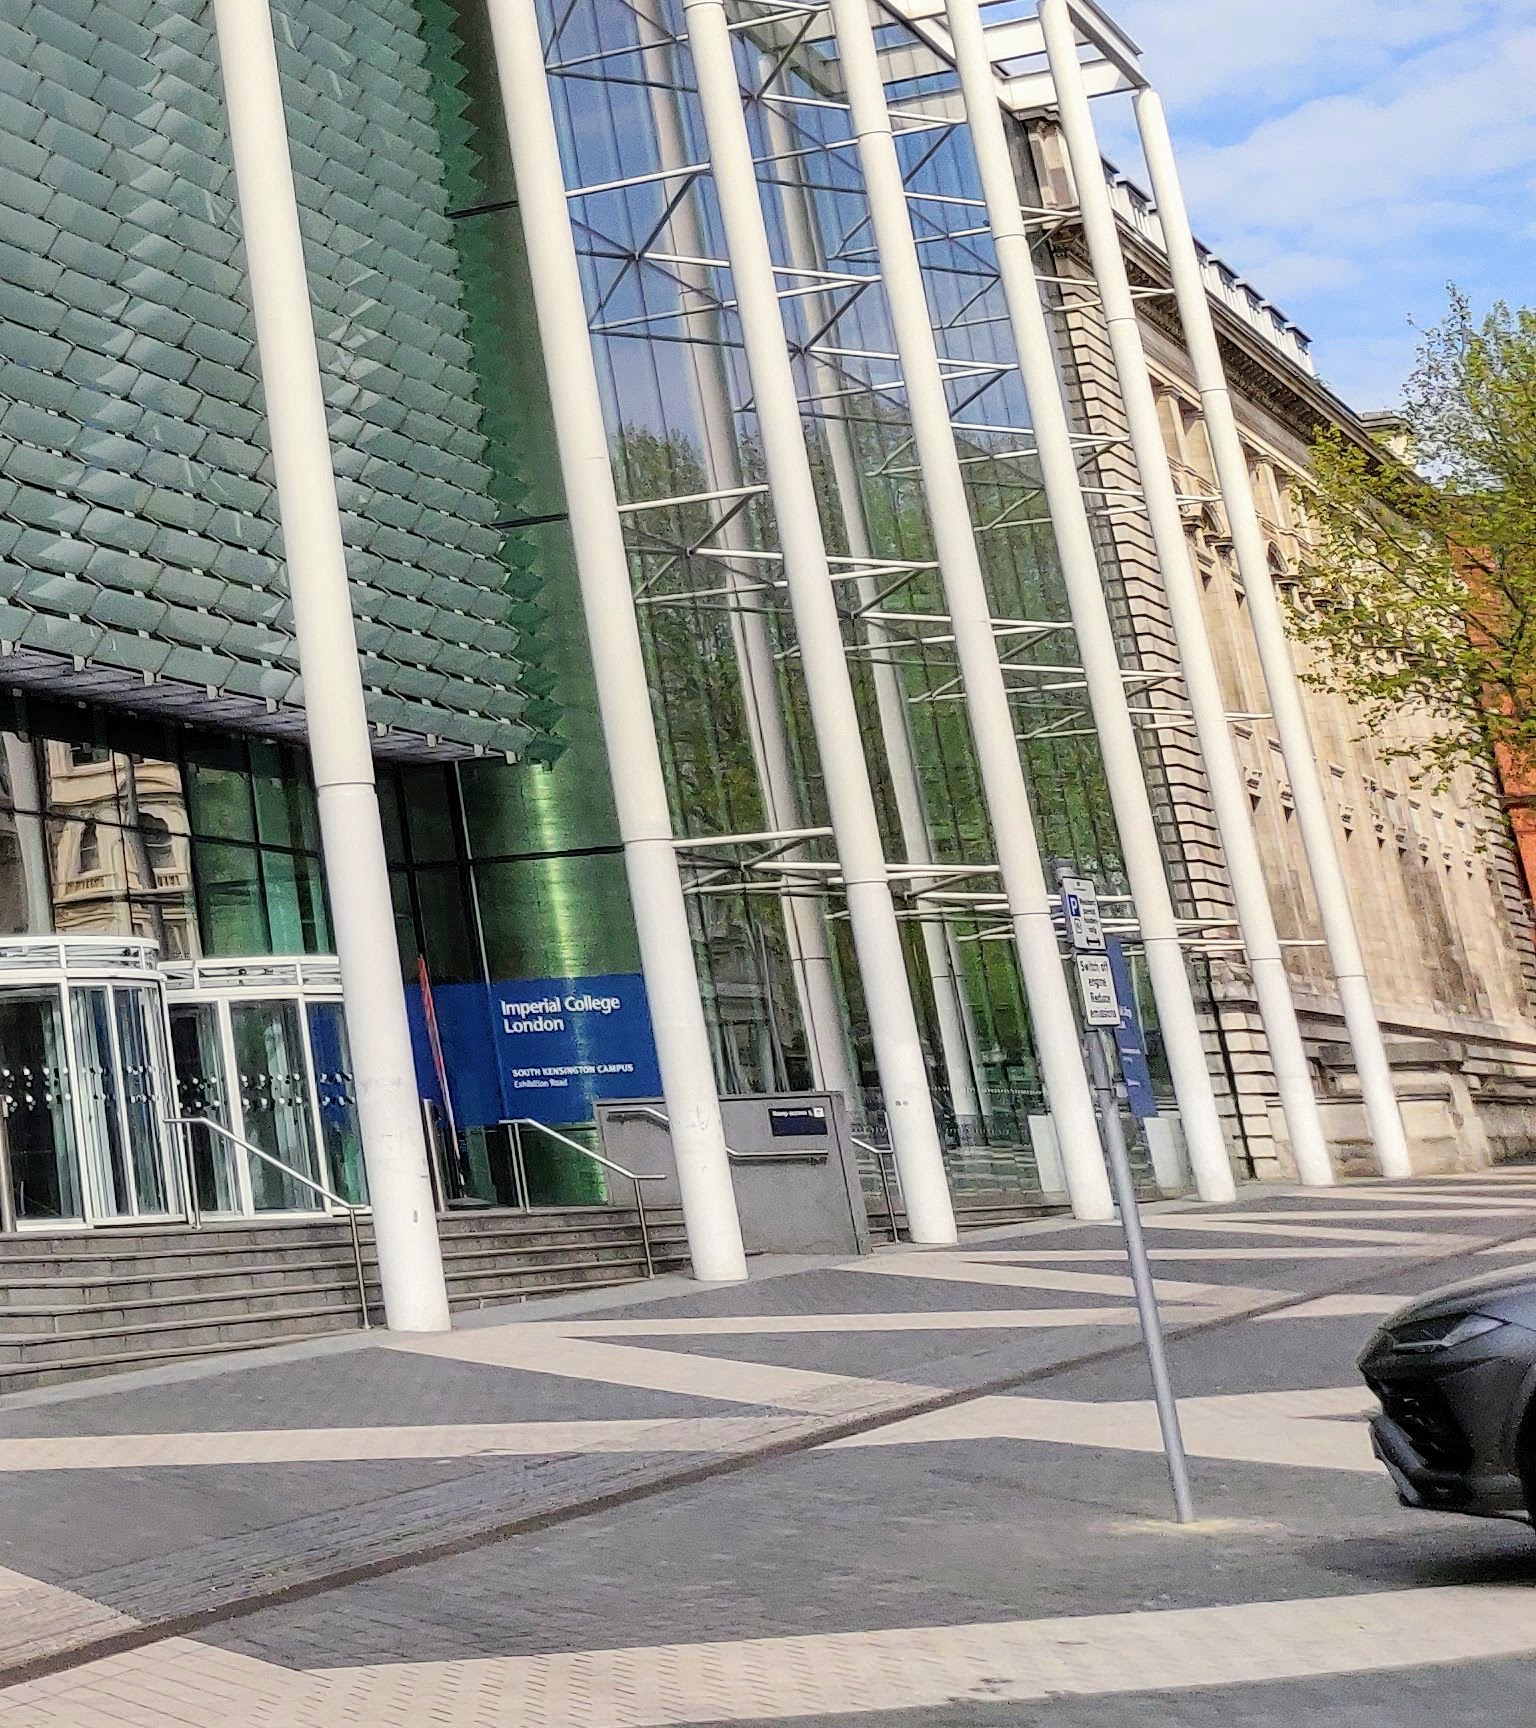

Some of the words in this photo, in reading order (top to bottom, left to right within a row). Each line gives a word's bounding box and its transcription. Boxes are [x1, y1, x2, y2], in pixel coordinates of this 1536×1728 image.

[500, 995, 562, 1019] Imperial
[563, 994, 621, 1014] College
[503, 1016, 565, 1033] London
[512, 1068, 542, 1078] SOUTH
[541, 1065, 596, 1077] KENSINGTON
[596, 1063, 634, 1074] CAMPUS
